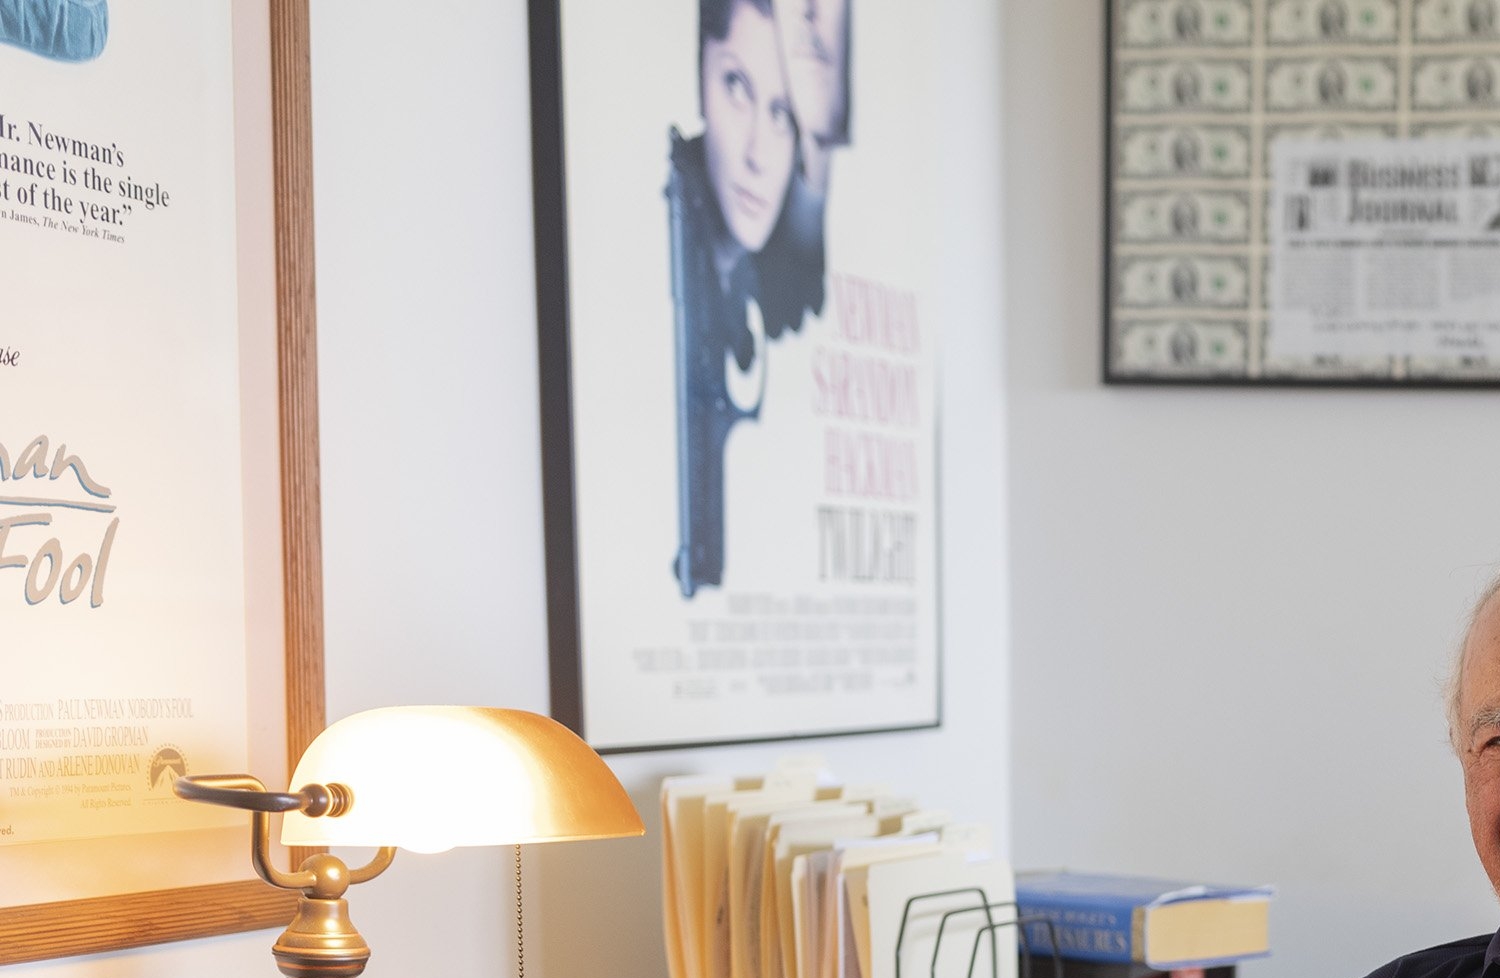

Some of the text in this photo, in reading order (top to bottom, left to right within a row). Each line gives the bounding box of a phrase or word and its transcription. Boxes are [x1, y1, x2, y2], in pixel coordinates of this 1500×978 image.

[0, 114, 124, 168] r. Newman's
[17, 183, 38, 206] of
[43, 188, 73, 215] the
[62, 160, 77, 186] is
[84, 167, 112, 194] the
[118, 176, 170, 210] single
[9, 210, 40, 227] James,
[42, 216, 58, 230] The
[61, 220, 79, 234] New
[81, 224, 99, 239] York
[102, 229, 125, 244] Times
[0, 728, 30, 750] LOOM
[73, 726, 103, 748] DAVID
[6, 756, 37, 779] RUDIN
[57, 755, 93, 777] ARLENE
[95, 753, 140, 776] DONOVAN
